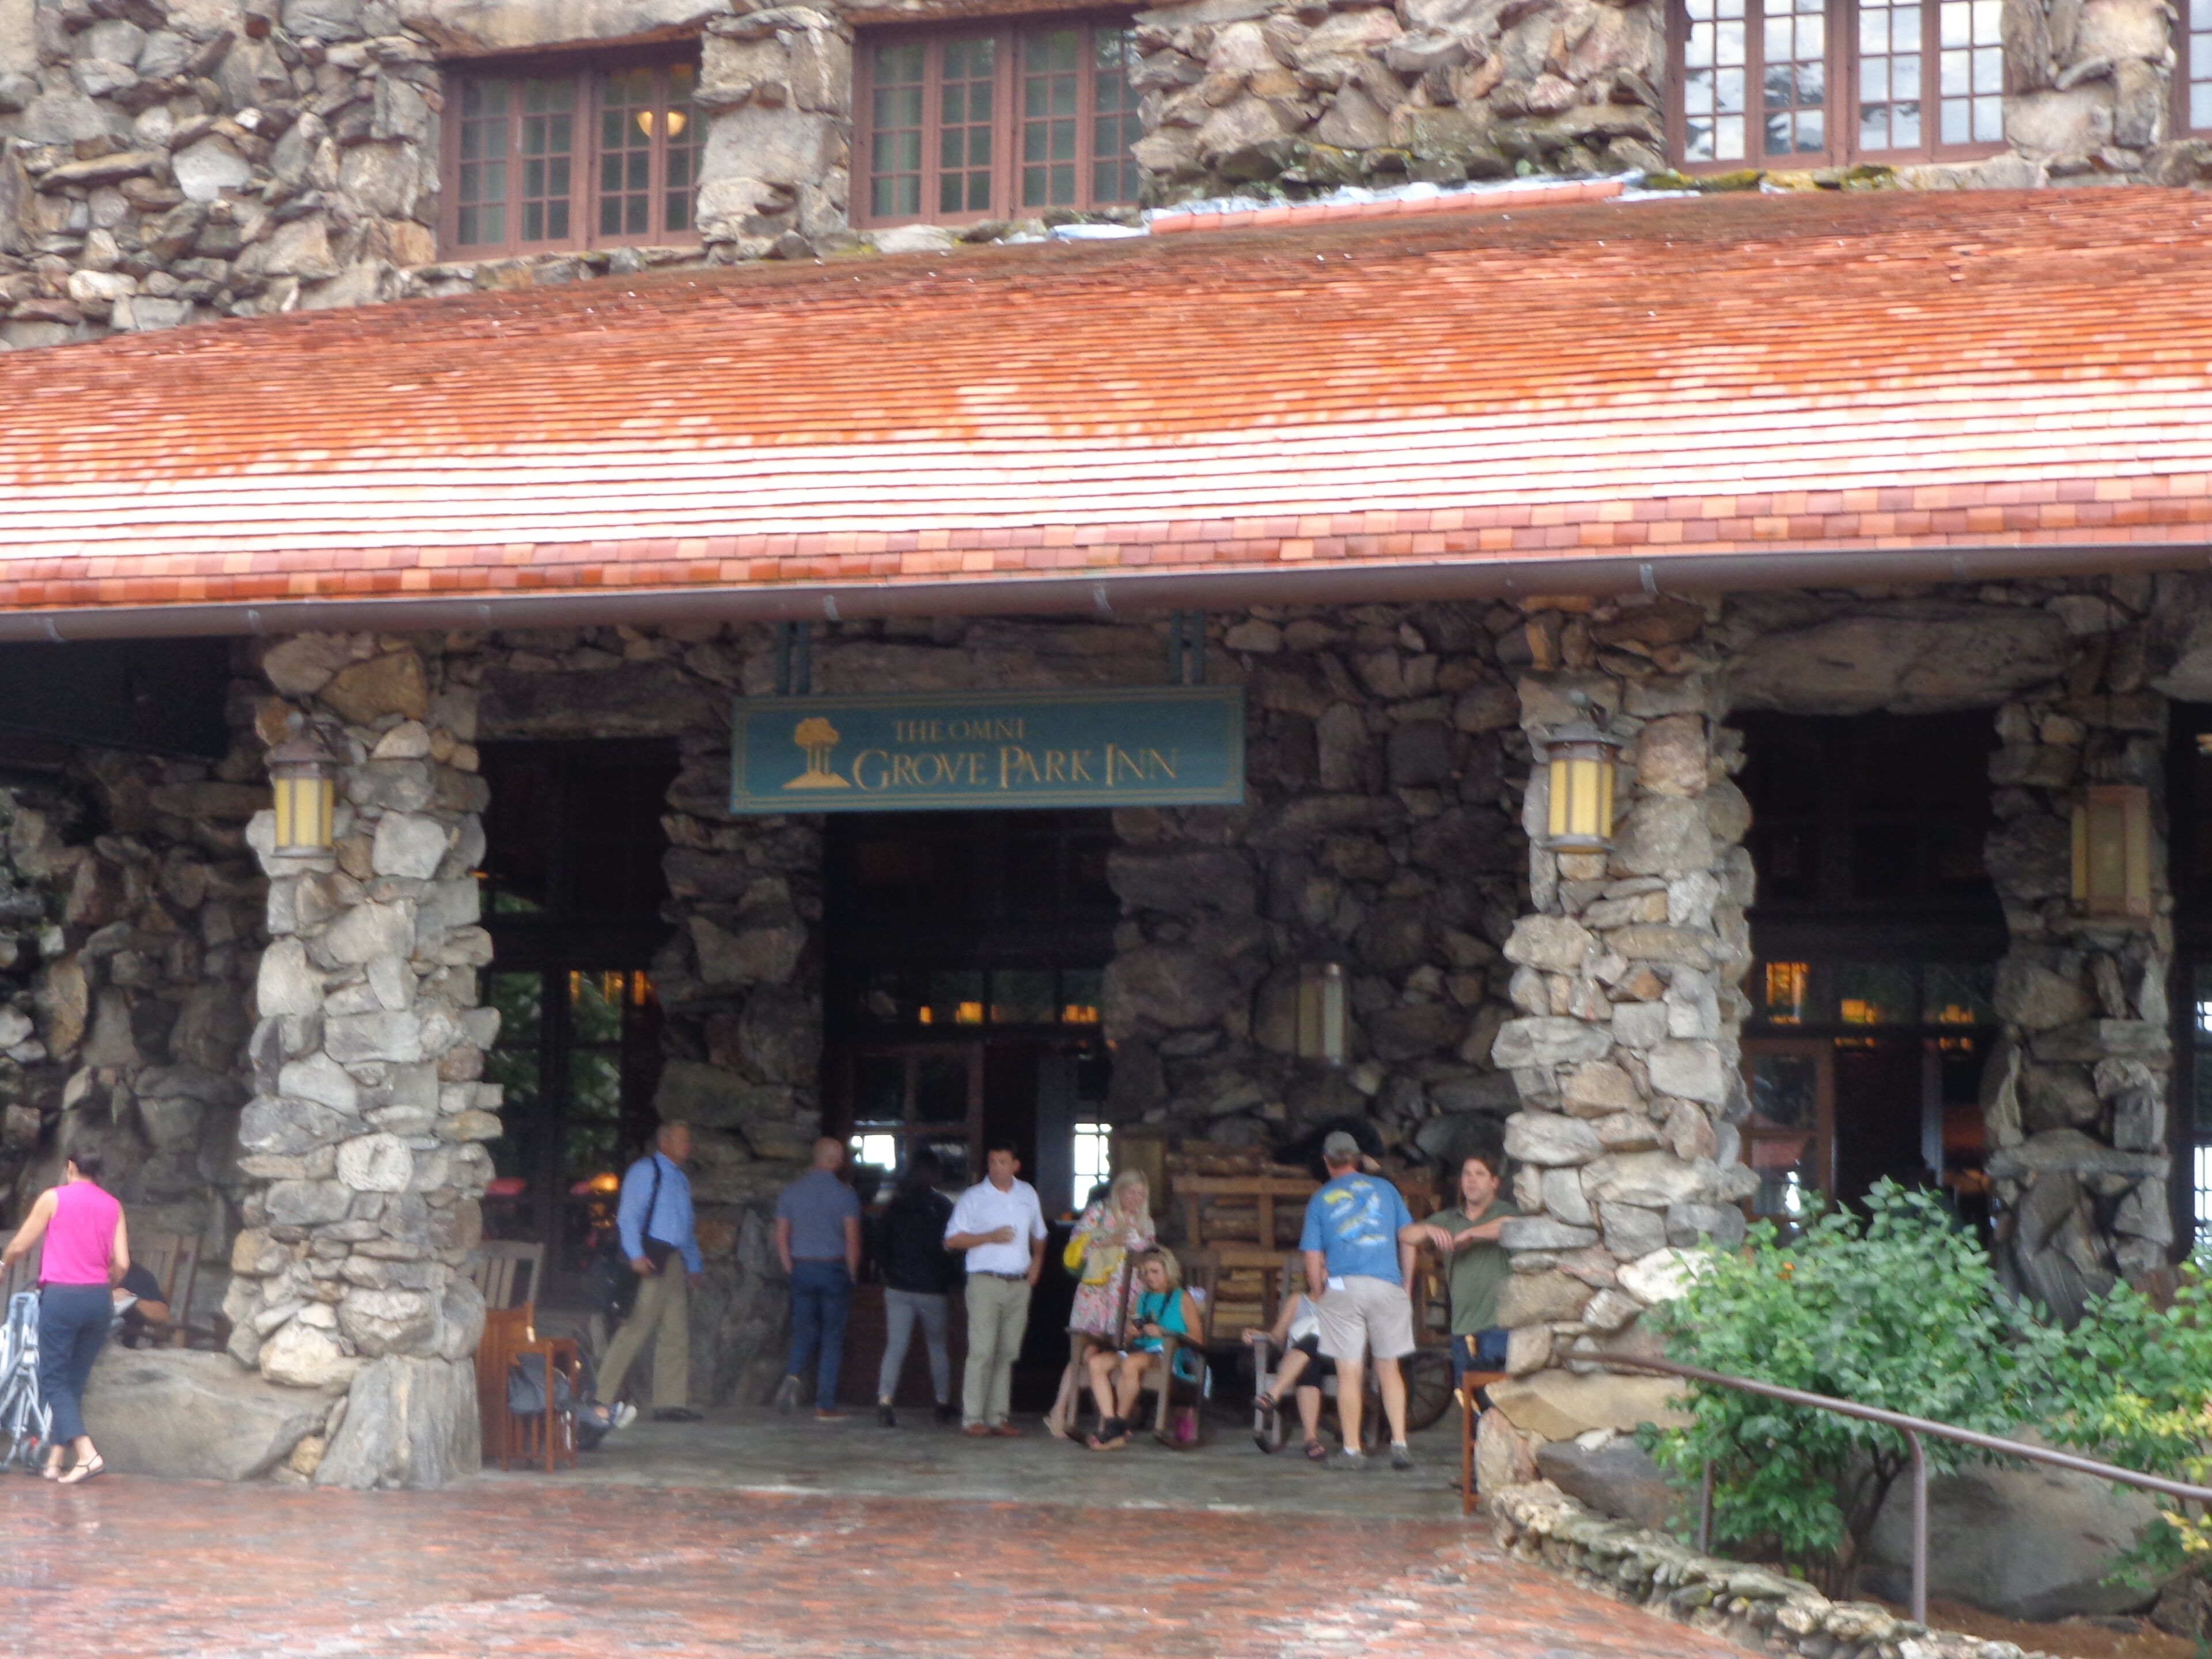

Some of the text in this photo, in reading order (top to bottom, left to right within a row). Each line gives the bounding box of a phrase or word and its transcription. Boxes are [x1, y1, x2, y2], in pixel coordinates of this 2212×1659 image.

[895, 718, 1026, 743] THE OMNI
[852, 743, 1179, 792] GROVE PARK INN
